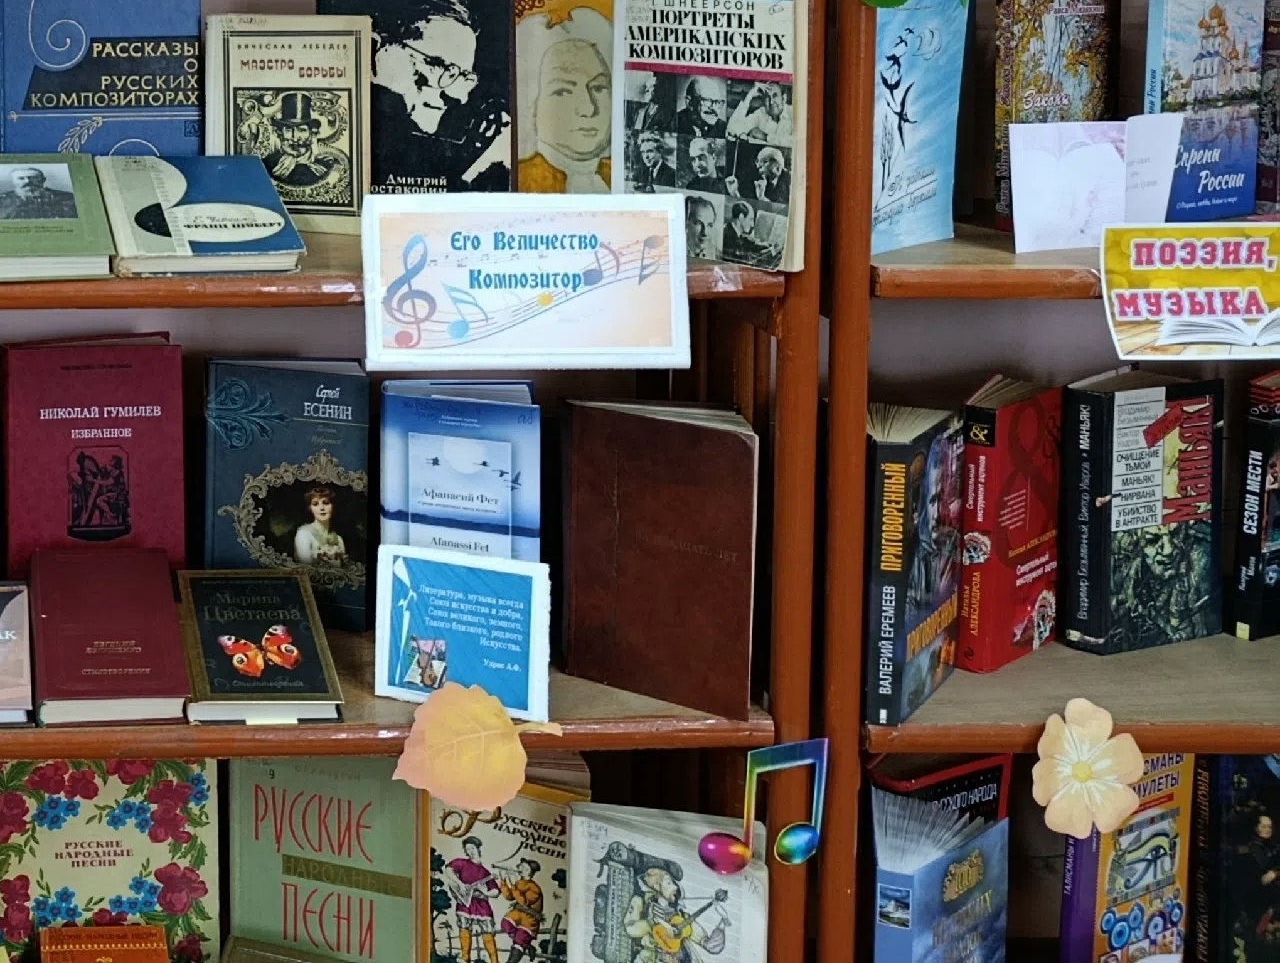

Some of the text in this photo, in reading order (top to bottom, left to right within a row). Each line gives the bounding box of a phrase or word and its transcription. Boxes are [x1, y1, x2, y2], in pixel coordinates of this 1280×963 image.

[652, 9, 755, 29] ПОРТРЕТЫ
[302, 42, 347, 50] ЛЕБЕДЕВ
[625, 26, 787, 51] АМЕРИКАНСКИХ
[91, 42, 200, 58] РАССКАЗЫ
[629, 43, 784, 70] КОМПОЗИТОРОВ
[184, 58, 199, 72] О
[240, 59, 295, 71] МАЭСТРО
[298, 67, 346, 78] БОРЬБЫ
[100, 75, 199, 90] РУССКИХ
[31, 91, 200, 107] КОМПОЗИТОРАХ
[385, 173, 448, 187] Дмитрий
[1198, 172, 1245, 194] России
[450, 232, 598, 252] Его Величество
[1135, 240, 1276, 270] ПОЭЗИЯ,
[470, 269, 582, 293] Композитор
[1116, 293, 1264, 318] МУЗЫКА
[316, 385, 340, 400] Сергей
[40, 405, 162, 420] НИКОЛАЙ ГУМИЛЕВ
[303, 402, 352, 420] ЕСЕНИН
[71, 428, 132, 439] ИЗБРАННОЕ
[1079, 403, 1091, 450] МАНЬЯК!
[1116, 450, 1159, 462] ОЧИЩЕНИЕ
[1125, 460, 1151, 471] ТЬМОЙ
[1121, 475, 1155, 487] МАНЬЯК!
[422, 488, 499, 505] Афанасий Фет
[1120, 489, 1156, 501] НИРВАНА
[1243, 451, 1263, 535] СЕЗОН МЕСТИ
[880, 463, 907, 572] ПРИГОВОРЕННЫЙ
[1117, 505, 1157, 517] УБИЙСТВО
[1122, 515, 1159, 527] АНТРАКТЕ
[431, 537, 489, 552] Afanassi Fet
[215, 593, 281, 607] Марина
[468, 593, 496, 605] музыка
[498, 599, 523, 609] всегда
[971, 572, 981, 636] АЛЕКСАНДРОВА
[203, 606, 303, 623] Цветаева
[424, 618, 451, 628] Такого
[491, 630, 523, 641] родного
[879, 585, 896, 695] ВАЛЕРИЙ ЕРЕМЕЕВ
[253, 783, 374, 864] РУССКИЕ
[64, 839, 123, 849] РУССКИЕ
[54, 848, 135, 859] НАРОДНЫЕ
[71, 858, 117, 868] ПЕСНИ
[1064, 845, 1074, 895] ТАЛИСМАНЫ
[281, 882, 376, 959] ПЕСНИ
